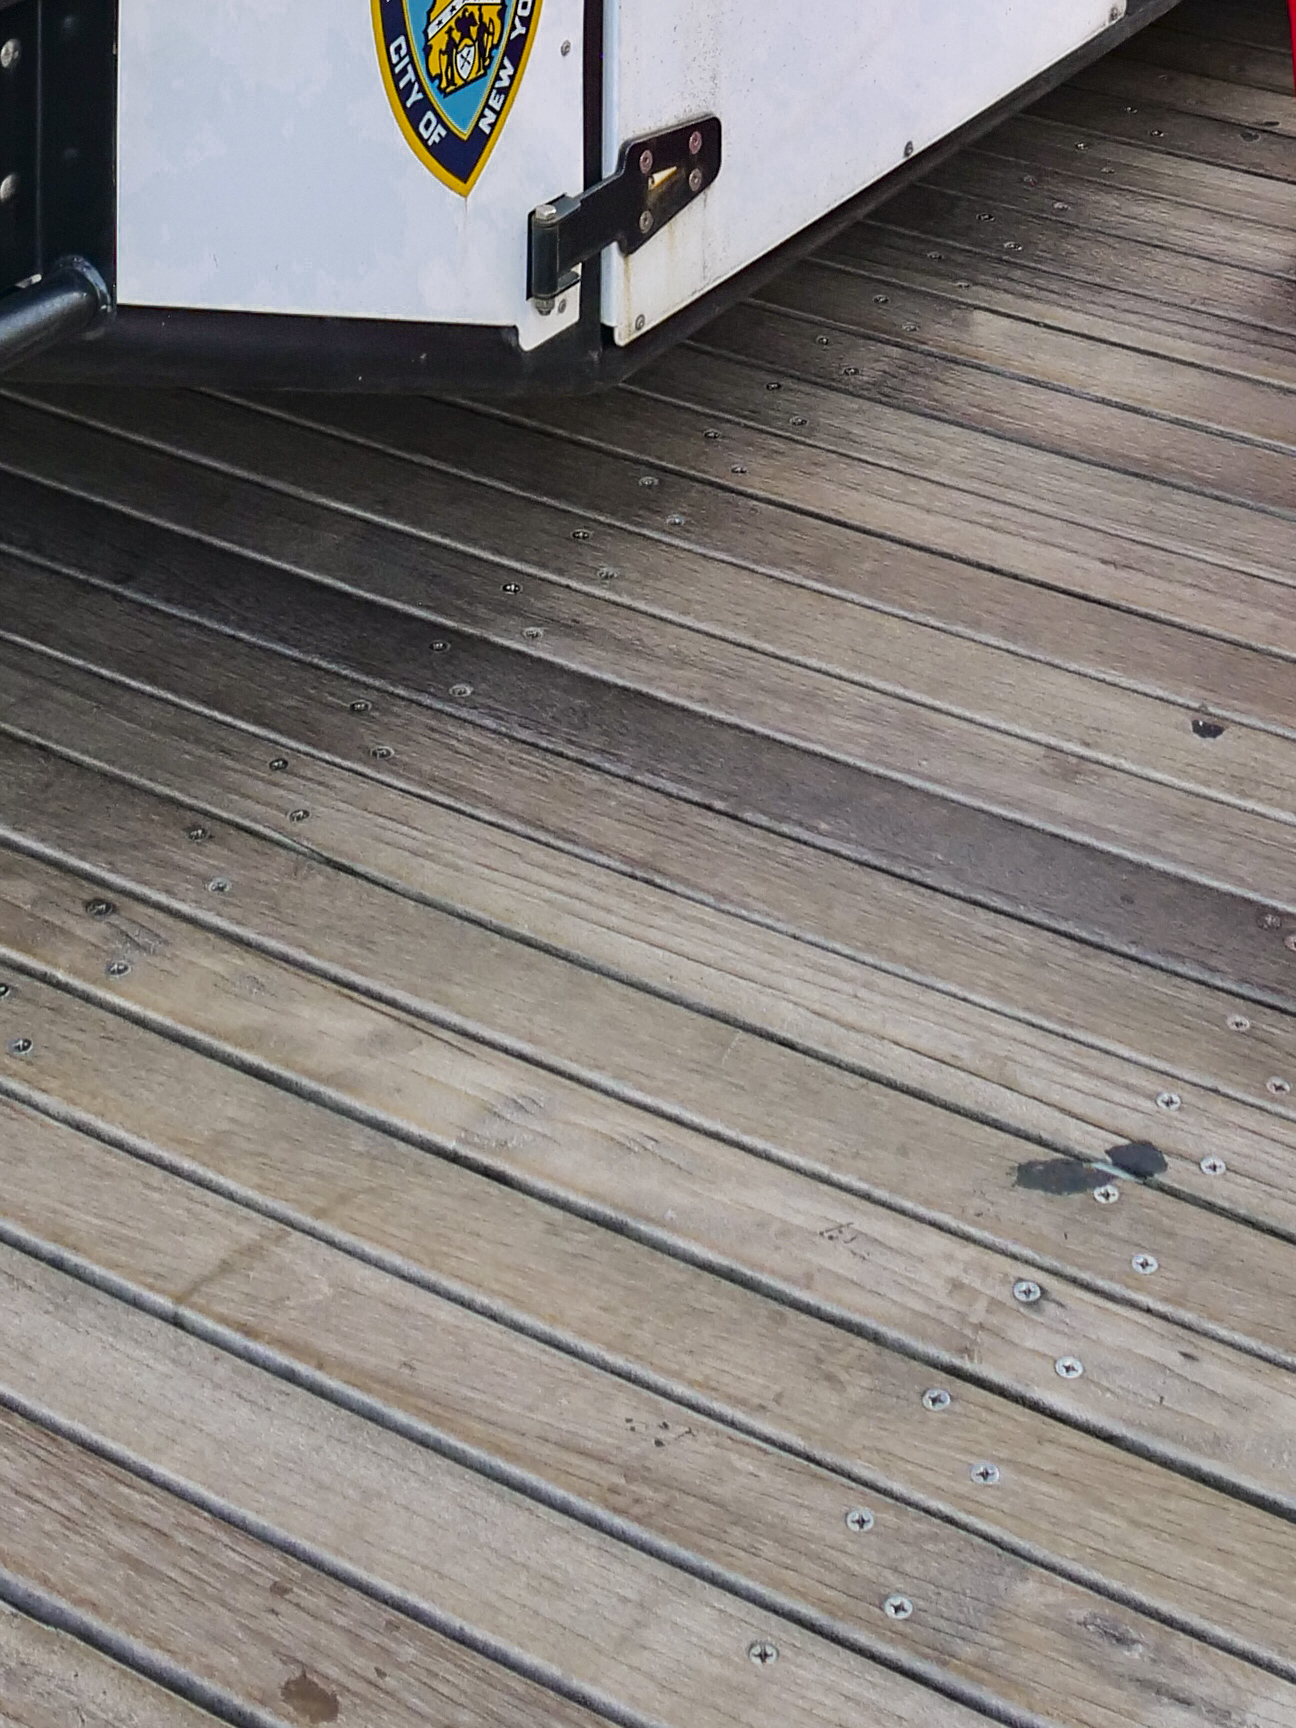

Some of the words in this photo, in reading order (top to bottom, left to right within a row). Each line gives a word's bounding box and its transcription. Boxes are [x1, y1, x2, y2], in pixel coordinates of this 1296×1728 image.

[389, 34, 423, 109] CITY
[418, 110, 447, 146] OF
[478, 57, 515, 135] NEW
